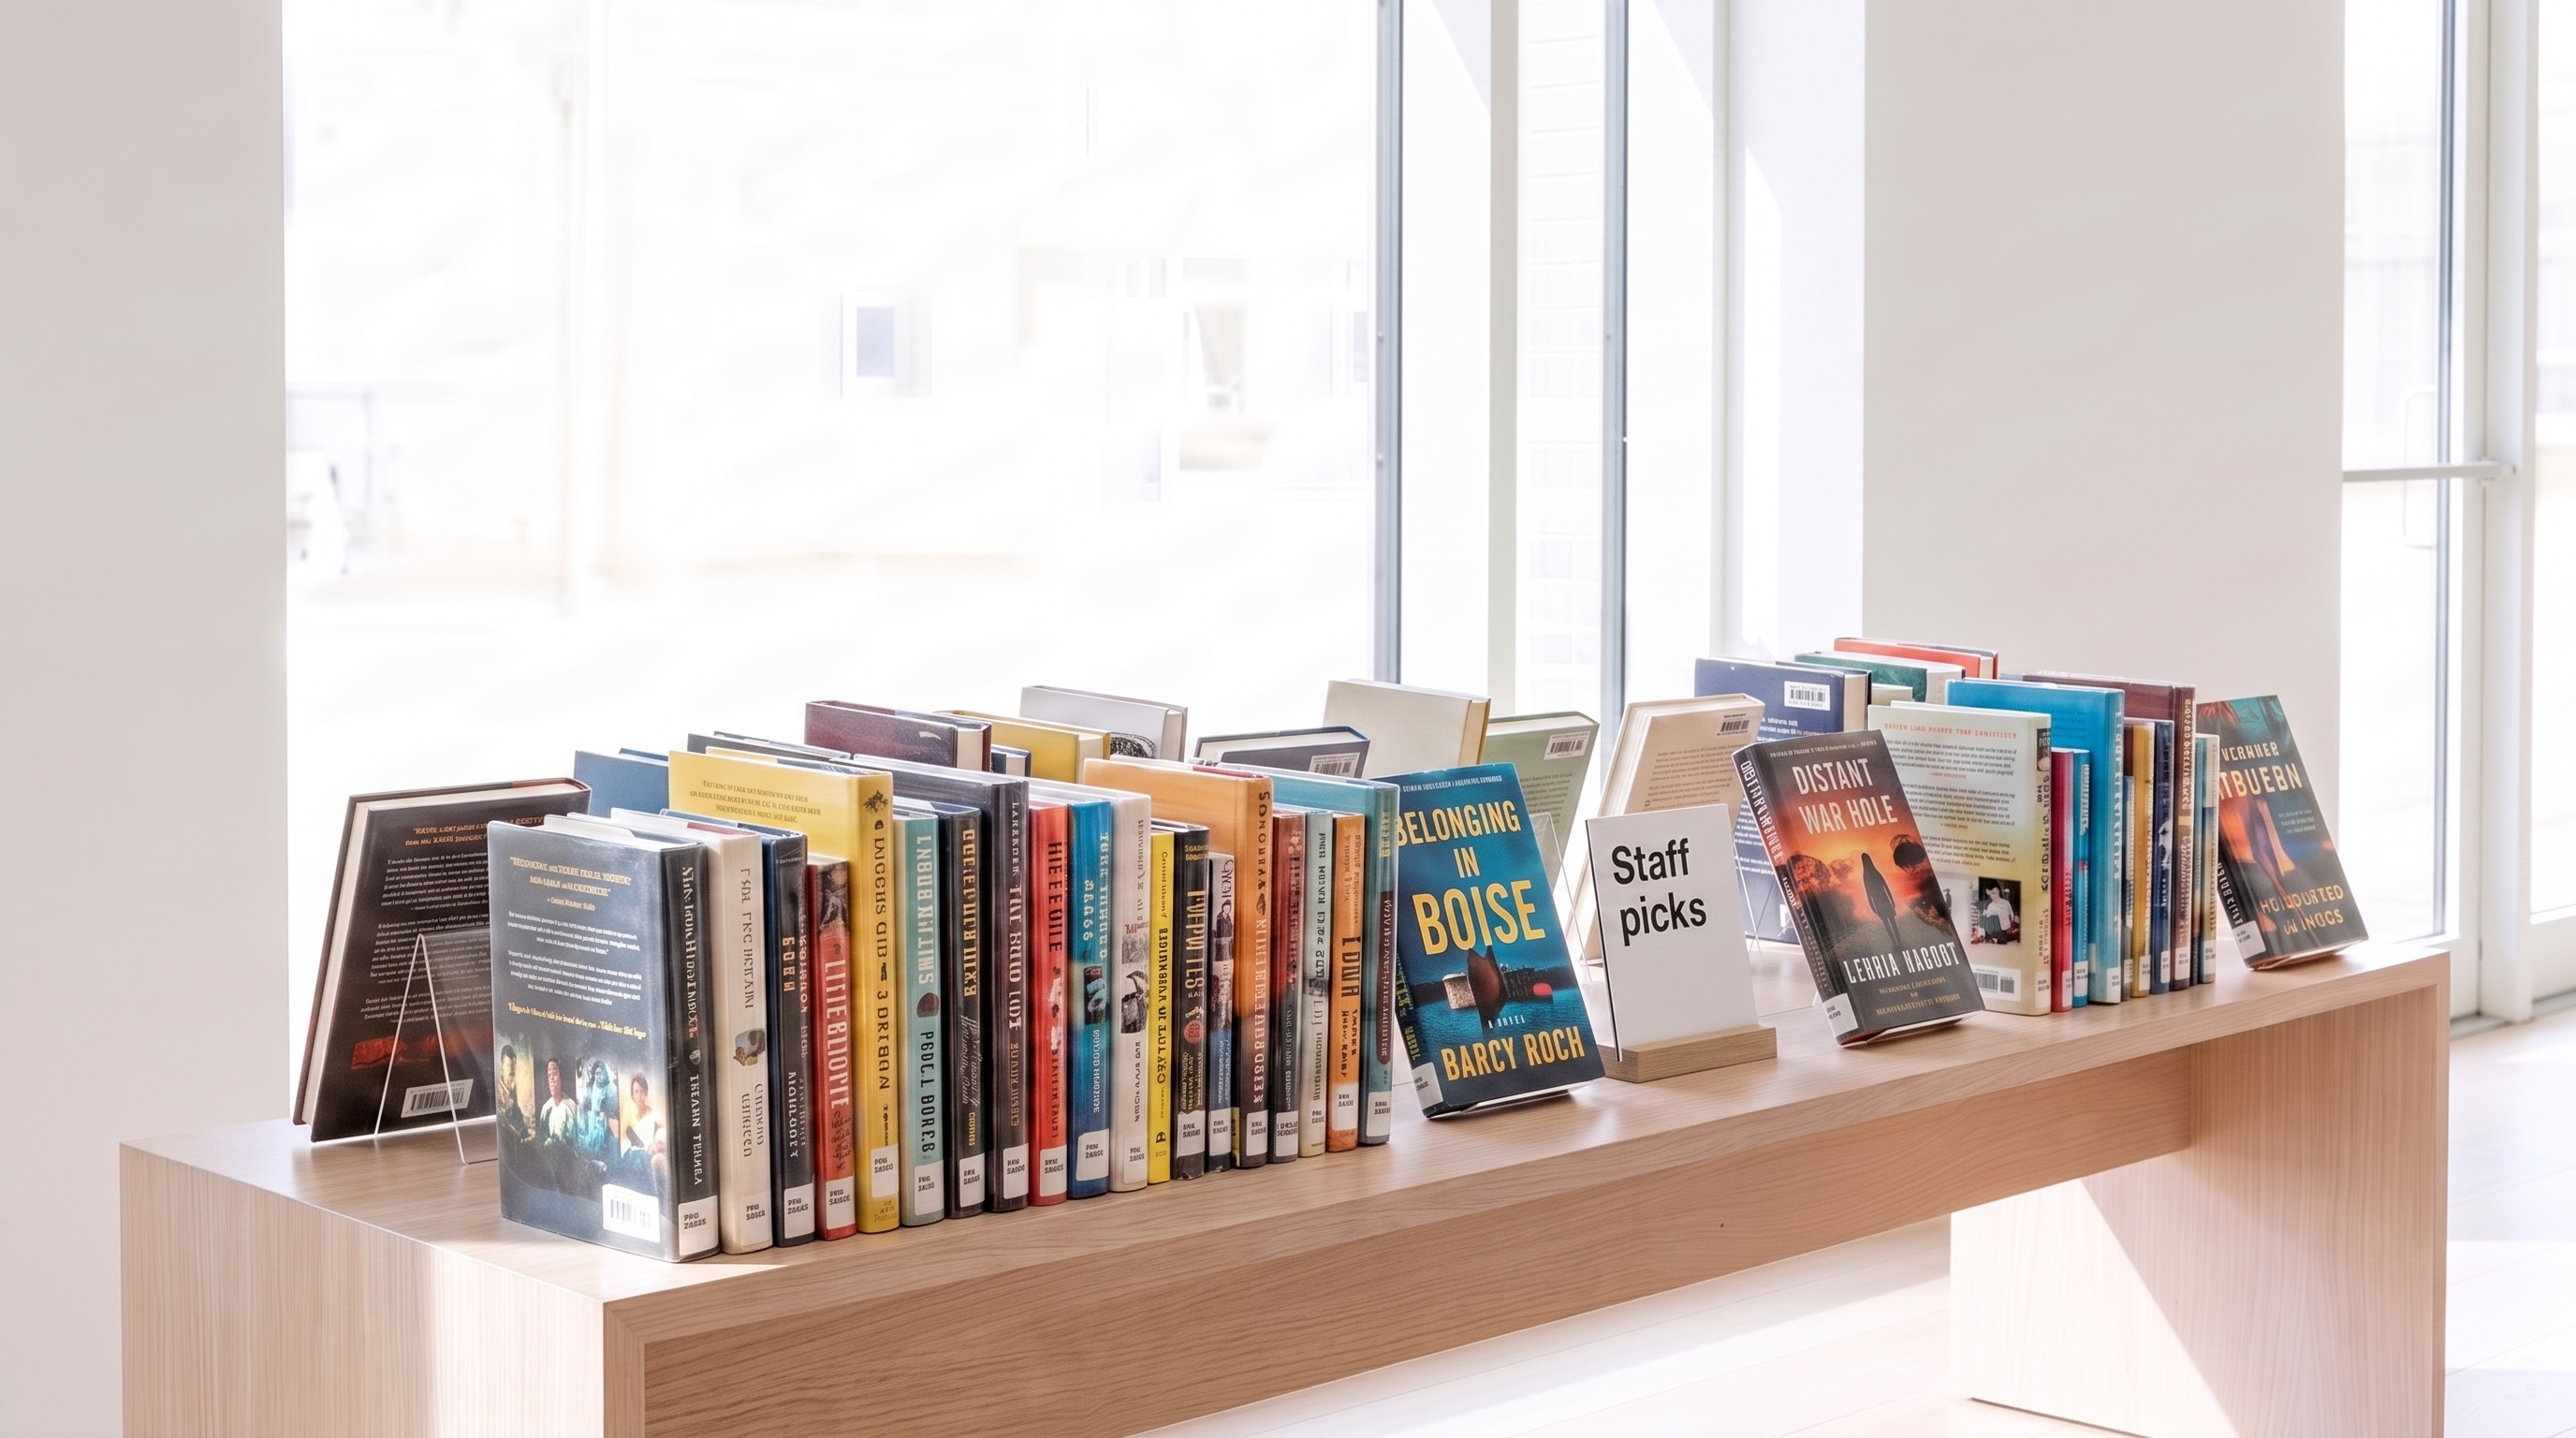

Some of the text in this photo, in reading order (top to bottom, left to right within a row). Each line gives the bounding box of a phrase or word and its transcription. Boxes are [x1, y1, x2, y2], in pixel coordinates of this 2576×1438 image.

[1792, 757, 1874, 795] DISTANT
[1395, 800, 1522, 847] BELONGING
[1797, 794, 1899, 835] WAR HOLE
[1453, 846, 1481, 879] IN
[1611, 838, 1690, 885] Staff
[1412, 879, 1546, 957] BOISE
[1619, 892, 1707, 946] picks
[1441, 1025, 1586, 1081] BARCY ROCH
